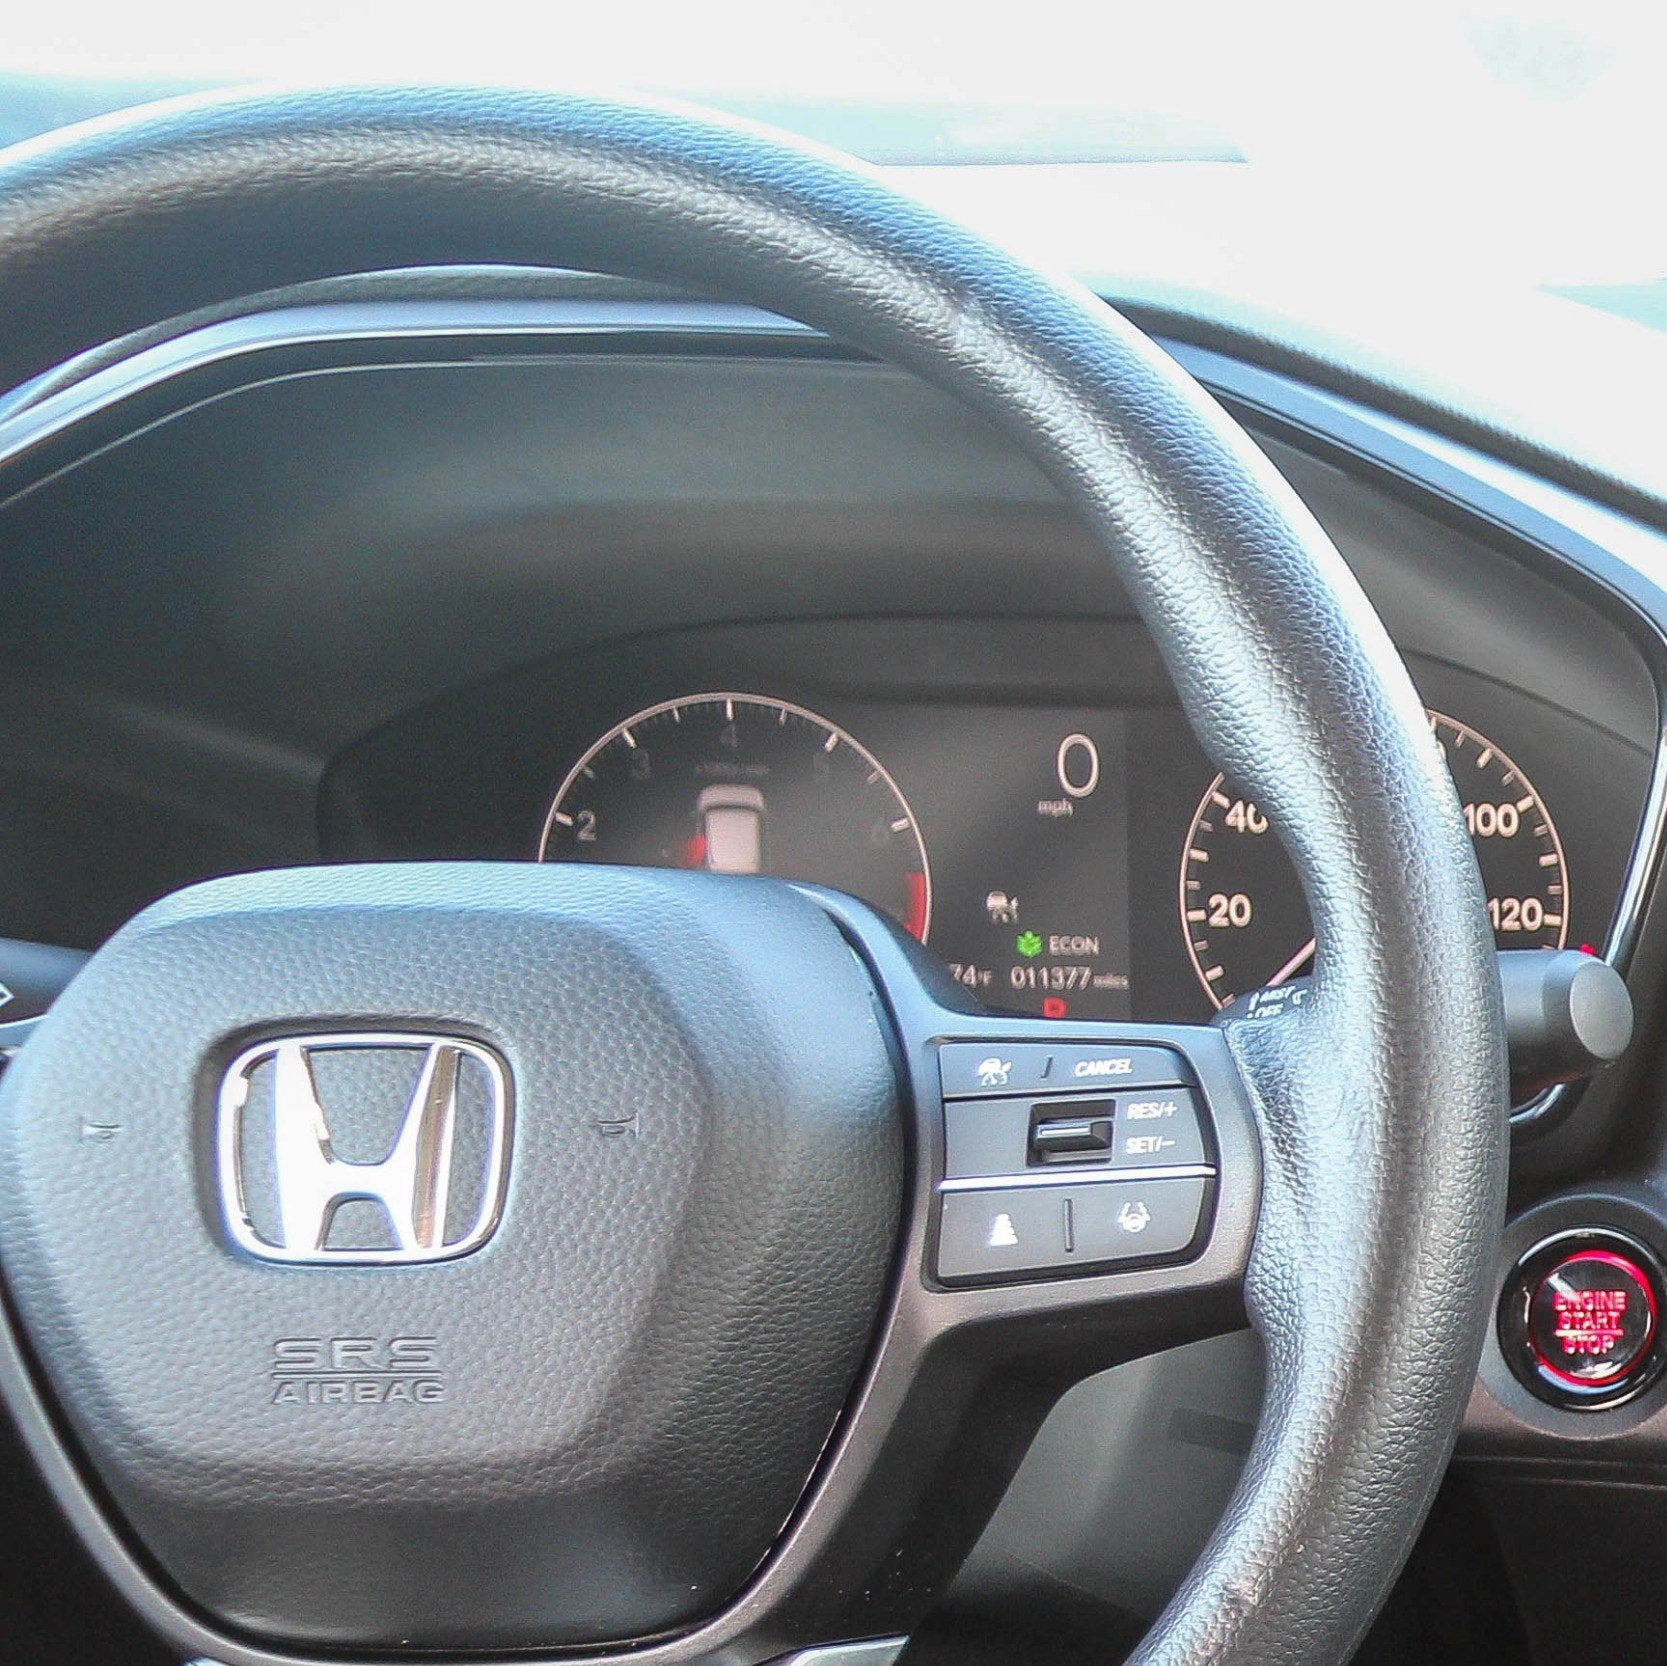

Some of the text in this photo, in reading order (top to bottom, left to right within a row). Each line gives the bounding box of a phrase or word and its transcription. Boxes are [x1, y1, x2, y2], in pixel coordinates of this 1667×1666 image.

[1058, 733, 1099, 797] 0
[575, 808, 598, 842] 2
[1463, 803, 1519, 838] 100
[1208, 894, 1251, 928] 20
[1488, 897, 1543, 931] 120
[1049, 935, 1099, 956] ECON
[1010, 965, 1092, 990] 011377
[1073, 1058, 1132, 1077] CANCEL
[1554, 1290, 1628, 1311] ENGINE
[1559, 1311, 1621, 1330] START
[273, 1337, 438, 1370] SRS
[1563, 1334, 1616, 1354] STOP
[272, 1379, 446, 1405] AIRBAG
